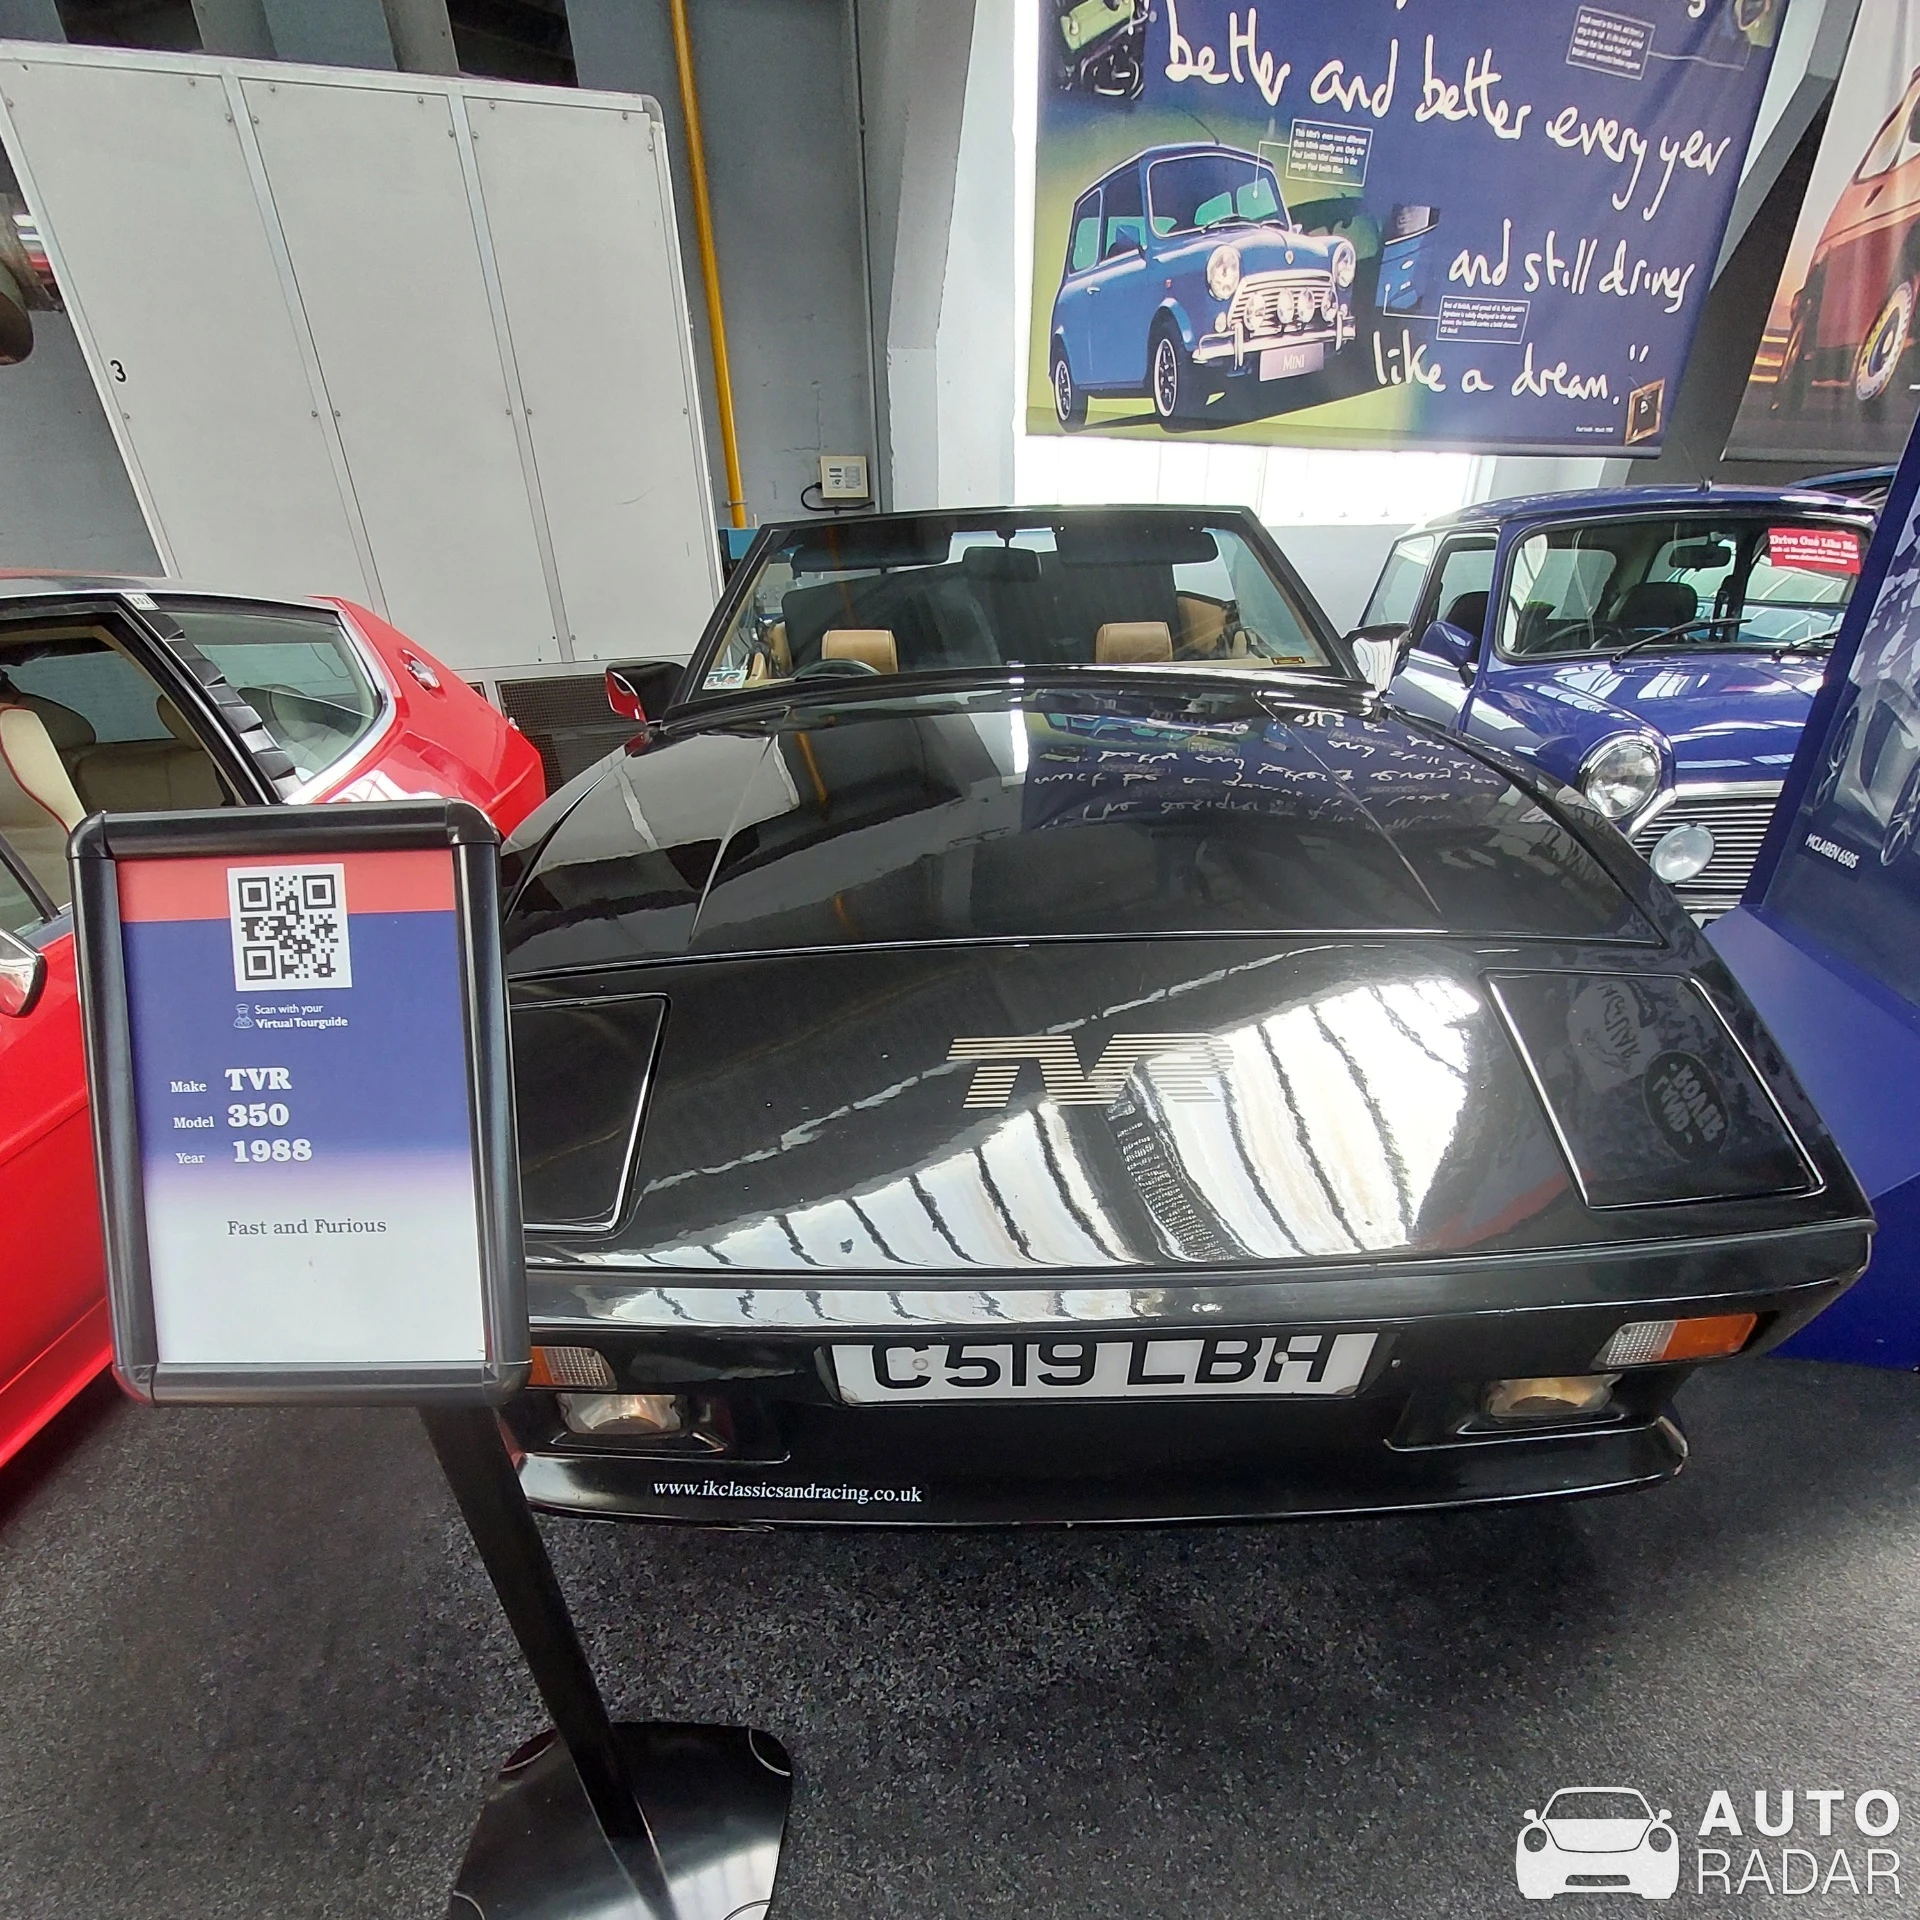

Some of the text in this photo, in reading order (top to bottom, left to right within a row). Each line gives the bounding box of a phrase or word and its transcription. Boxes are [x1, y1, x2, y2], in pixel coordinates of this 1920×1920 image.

[1165, 0, 1291, 106] better
[1310, 39, 1398, 118] and
[1415, 34, 1532, 140] better
[1546, 106, 1648, 211] every
[1449, 218, 1512, 288] and
[1524, 230, 1598, 294] still
[110, 360, 126, 382] 3
[1373, 329, 1447, 393] like
[1461, 368, 1494, 394] a
[1770, 535, 1798, 545] Drive
[1800, 536, 1819, 546] One
[1821, 538, 1841, 548] Like
[1805, 833, 1860, 869] MCLAREN 650S
[254, 1004, 324, 1016] Scan with your
[255, 1016, 349, 1030] Virtual Tourguide
[170, 1067, 292, 1094] Make TVR
[173, 1102, 289, 1129] Model 350
[176, 1138, 312, 1165] Year 1988
[227, 1217, 387, 1236] Fast and Furious
[872, 1333, 1338, 1389] C519 LBH
[653, 1479, 923, 1505] www.ikclassicsandracing.co.uk
